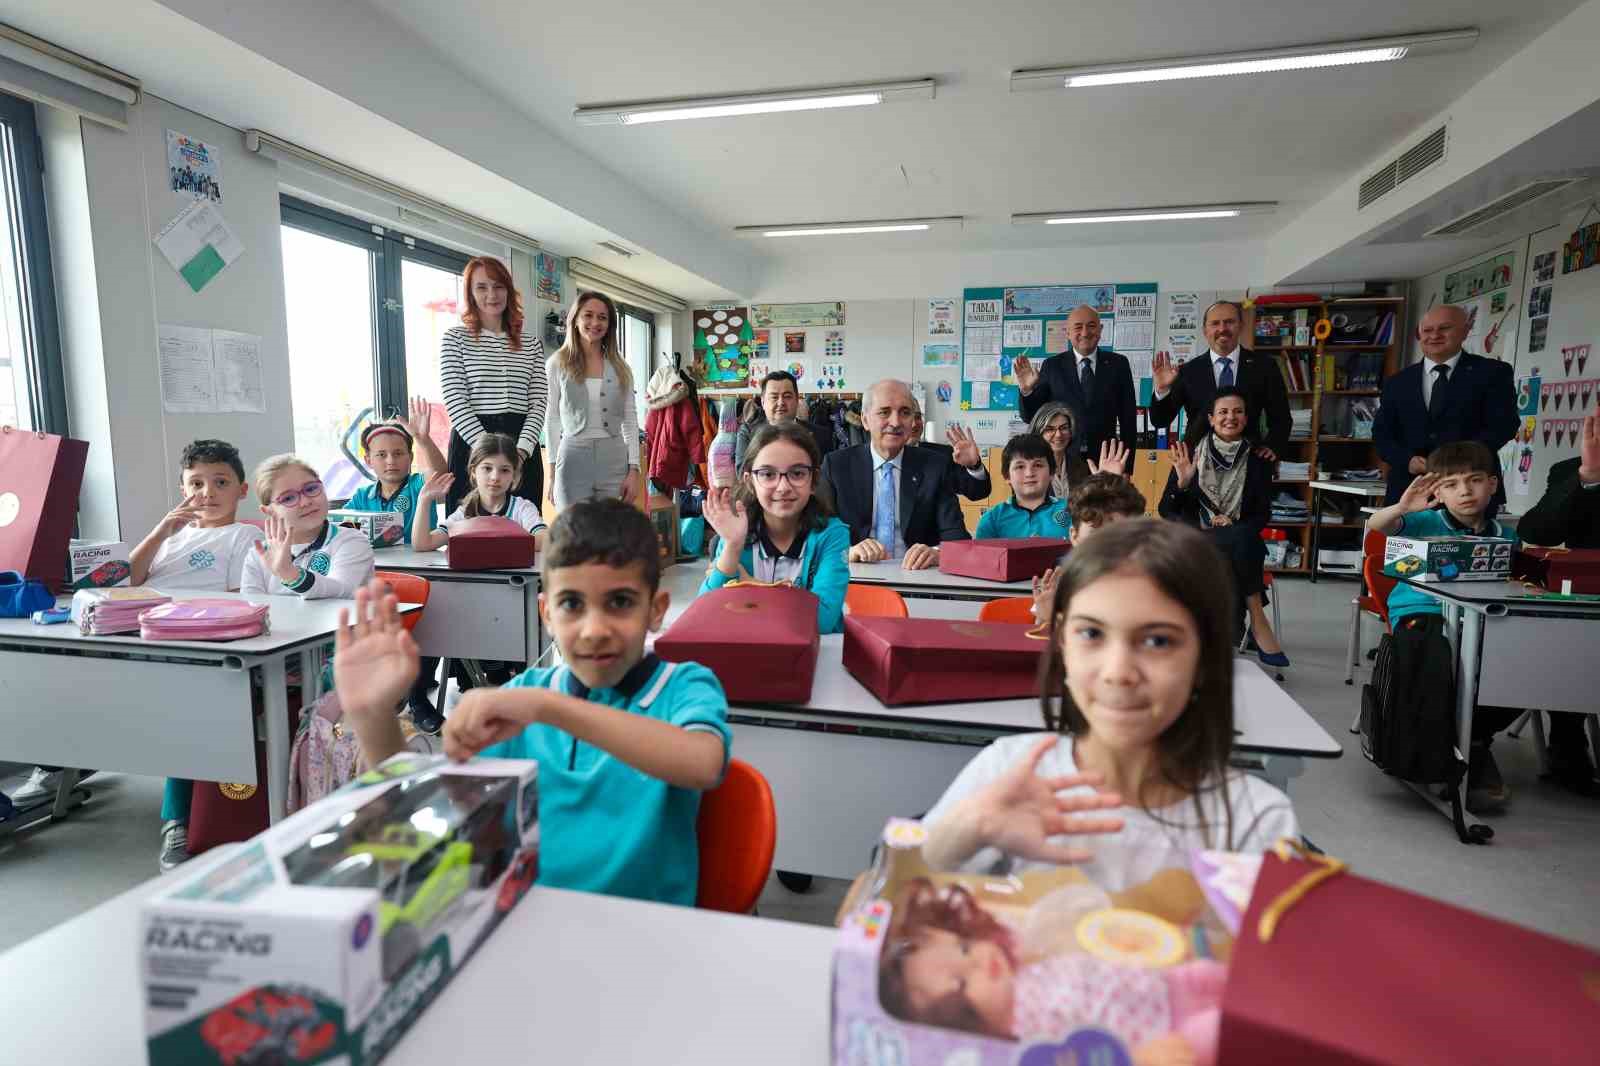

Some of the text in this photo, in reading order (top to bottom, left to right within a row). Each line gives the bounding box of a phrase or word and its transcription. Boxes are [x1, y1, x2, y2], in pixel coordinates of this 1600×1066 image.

[1121, 296, 1147, 306] TABLA
[971, 302, 995, 312] TABLA
[73, 549, 111, 559] RACING
[146, 927, 272, 956] RACING
